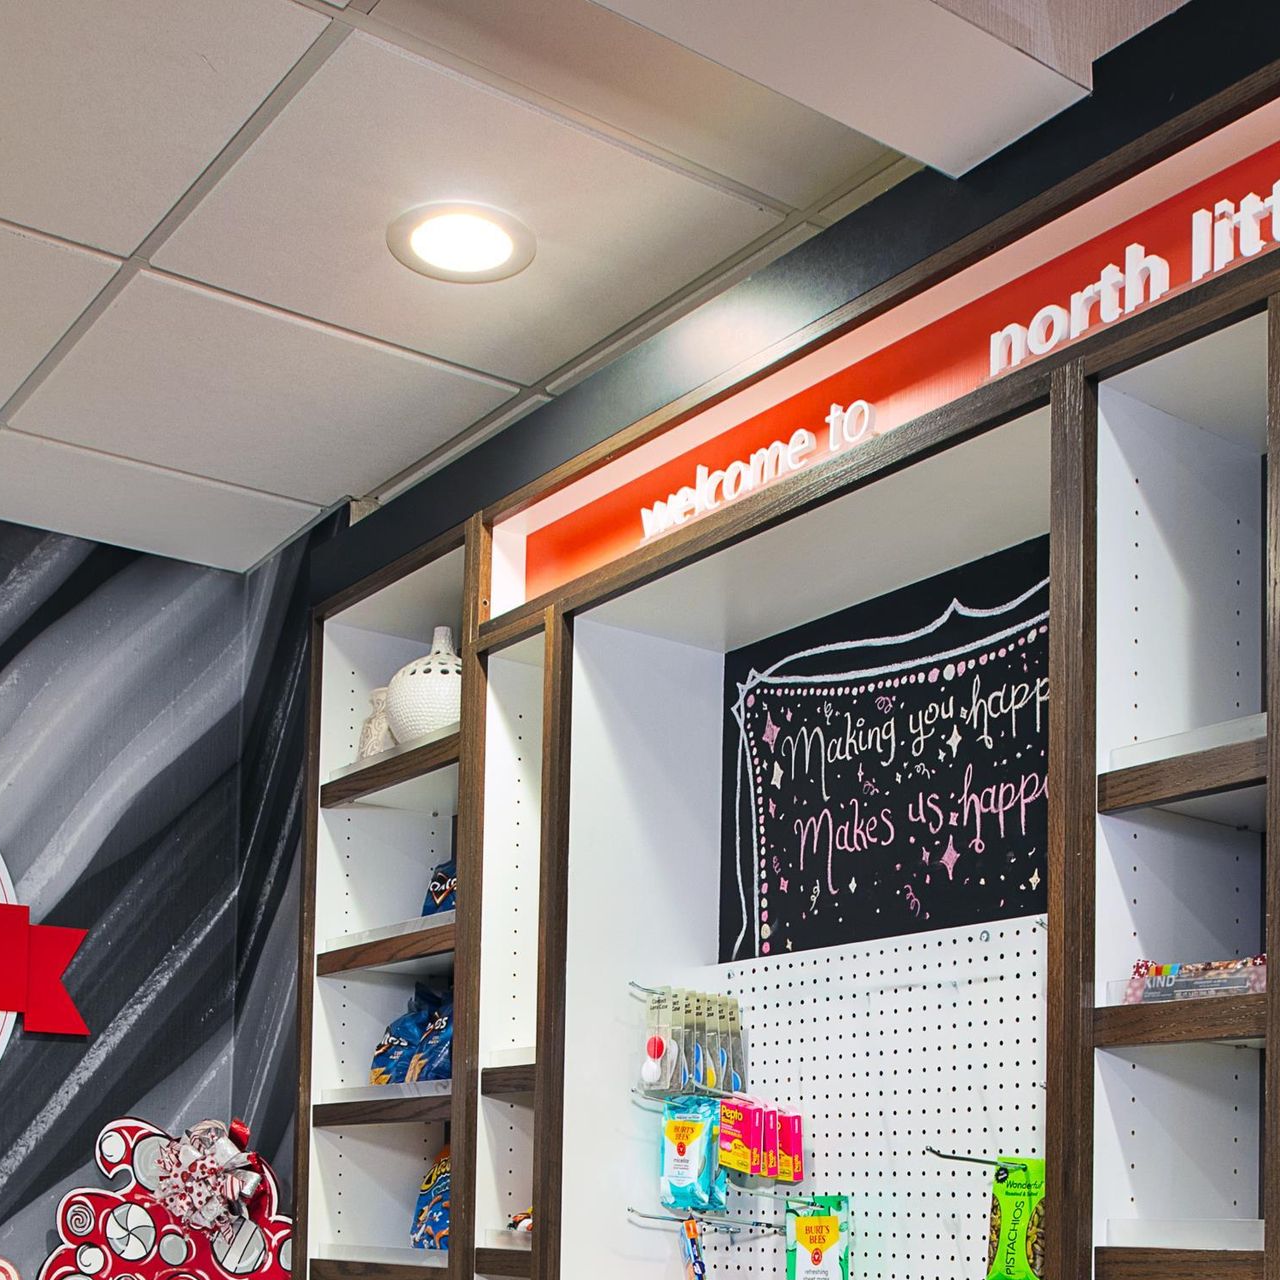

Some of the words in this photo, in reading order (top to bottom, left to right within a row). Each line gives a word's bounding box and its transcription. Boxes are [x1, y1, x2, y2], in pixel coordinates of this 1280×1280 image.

[989, 242, 1169, 377] north
[641, 428, 816, 539] welcome
[825, 400, 875, 451] to
[782, 712, 897, 801] Making
[909, 696, 955, 757] you
[794, 797, 895, 895] Makes
[908, 791, 944, 835] us
[1144, 975, 1175, 989] KIND
[721, 1106, 744, 1122] Pepto
[809, 1234, 827, 1244] BEES
[1006, 1200, 1025, 1276] PISTACHIOS
